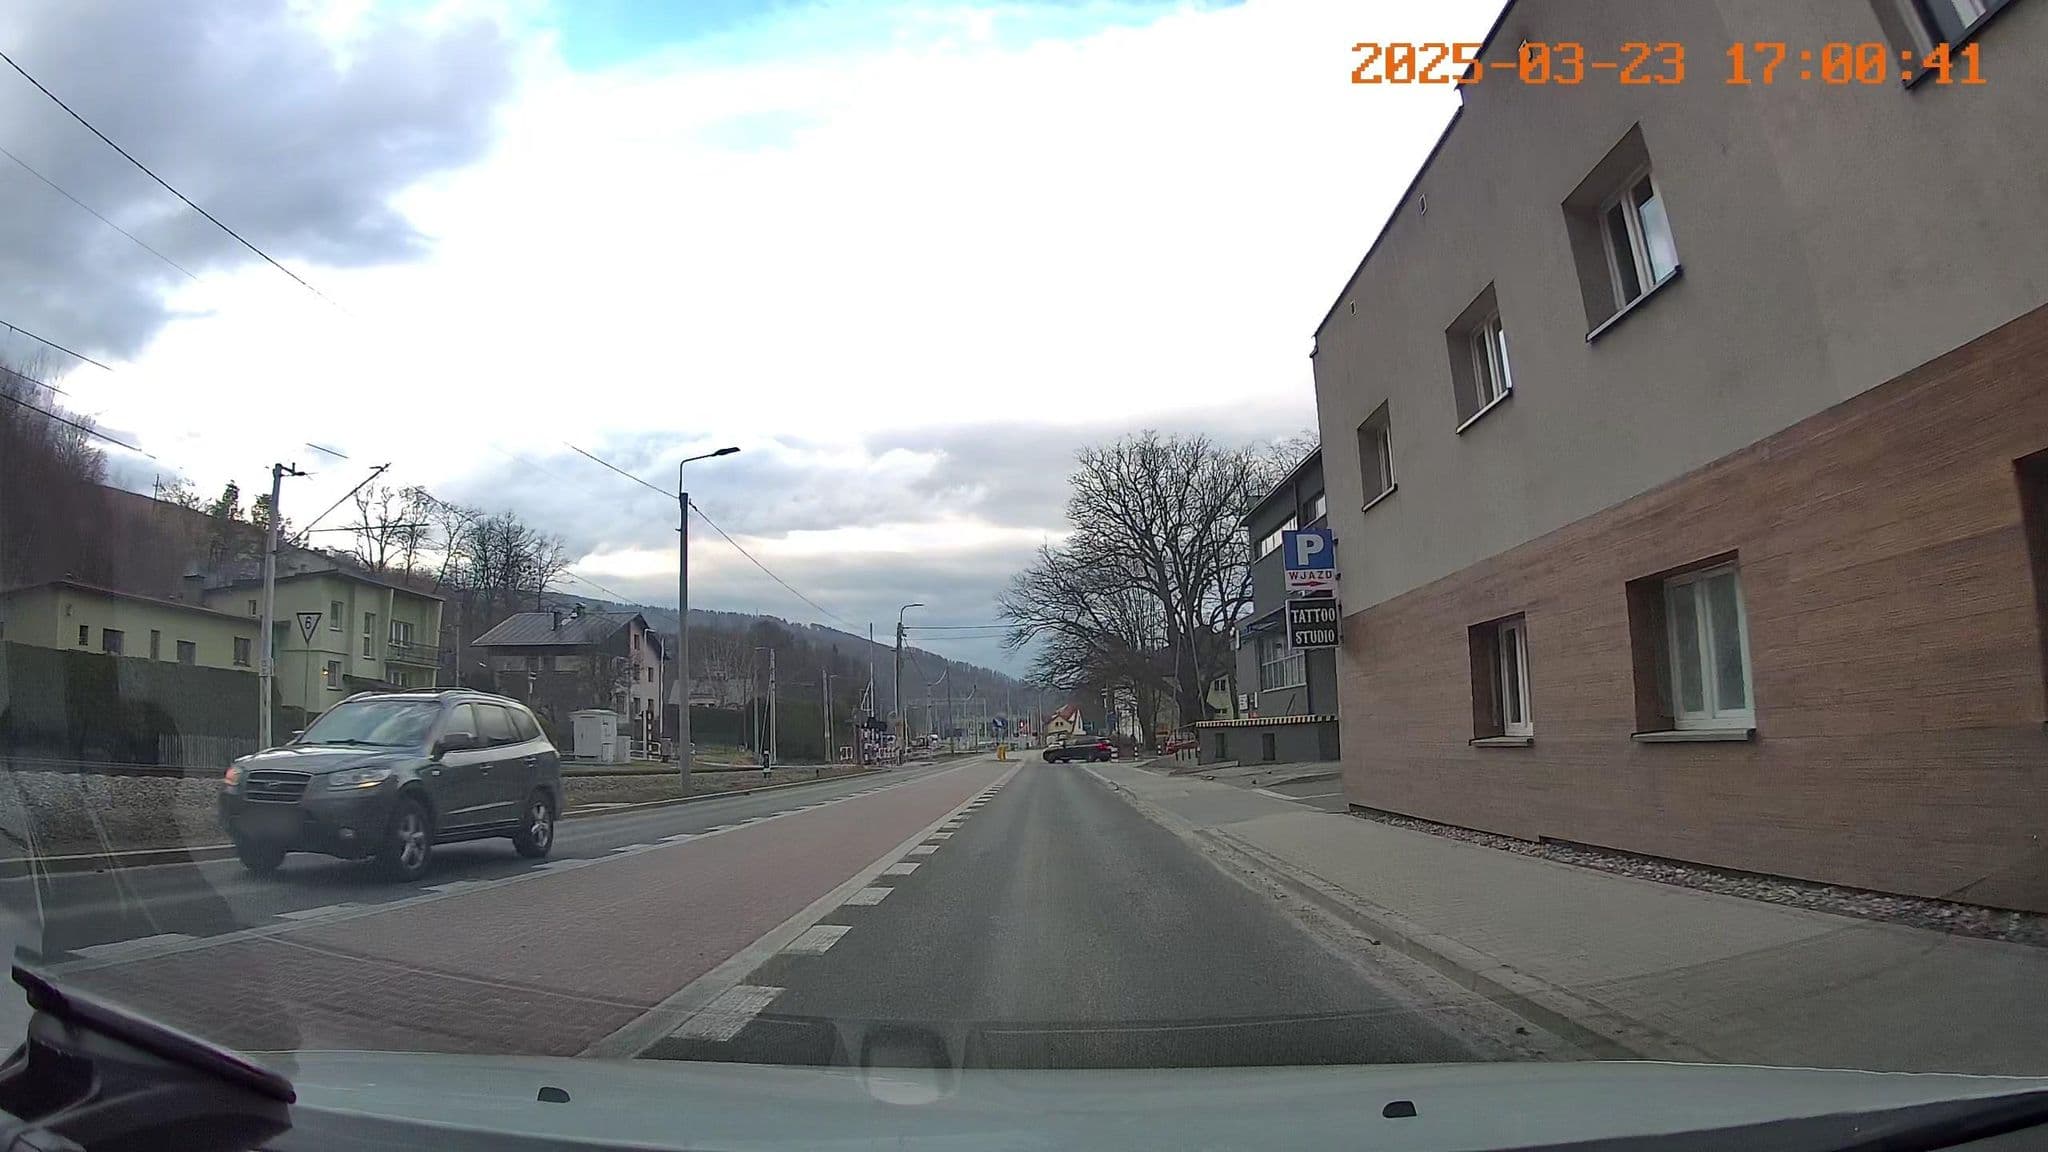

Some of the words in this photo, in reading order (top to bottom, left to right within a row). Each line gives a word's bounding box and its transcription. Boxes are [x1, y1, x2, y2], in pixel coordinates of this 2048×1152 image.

[1296, 533, 1325, 566] P
[1289, 570, 1333, 581] WJAZD
[1291, 607, 1336, 624] TATTOO
[1295, 628, 1335, 645] STUDIO
